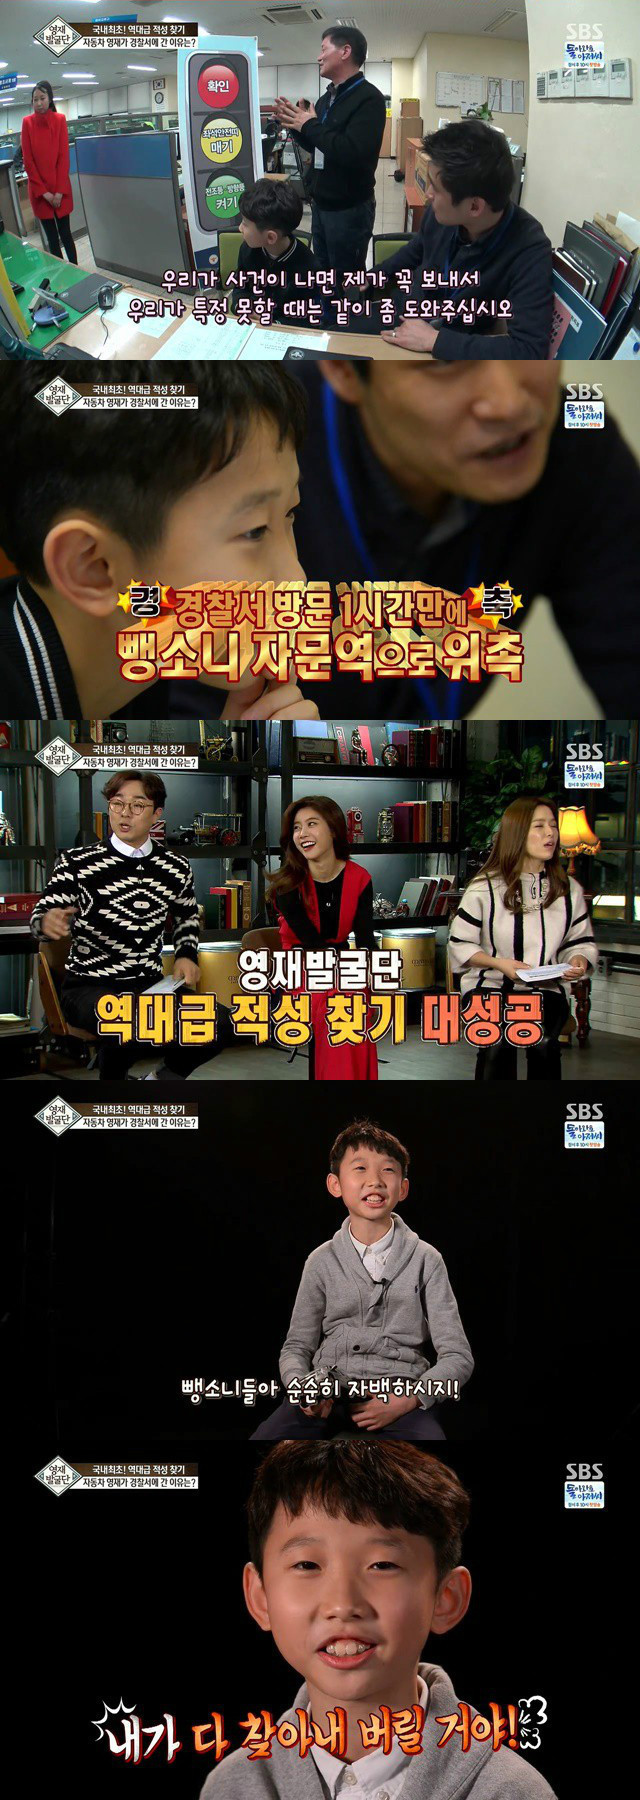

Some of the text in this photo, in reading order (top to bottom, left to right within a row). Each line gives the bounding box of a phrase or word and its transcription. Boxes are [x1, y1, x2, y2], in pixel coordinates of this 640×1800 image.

[207, 79, 230, 93] 확인
[202, 127, 239, 138] 좌석안전띠
[210, 140, 233, 155] 매기
[216, 196, 238, 210] 켜기
